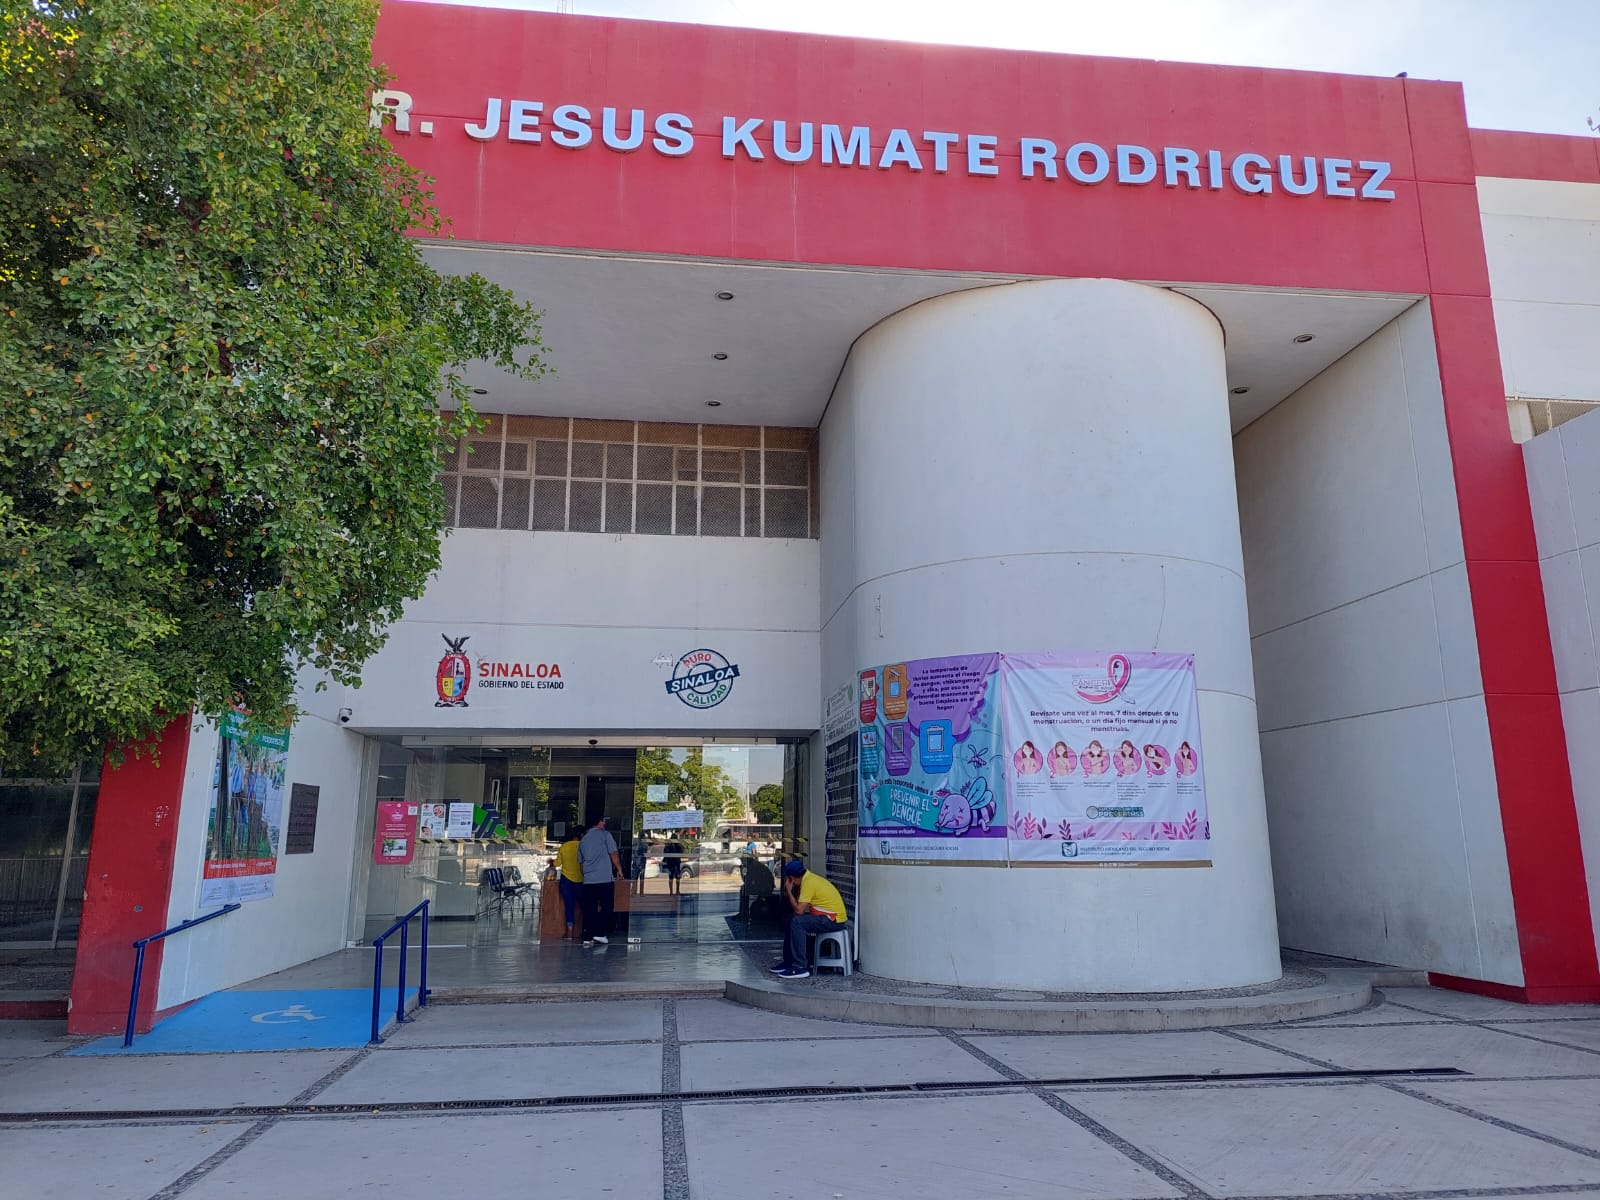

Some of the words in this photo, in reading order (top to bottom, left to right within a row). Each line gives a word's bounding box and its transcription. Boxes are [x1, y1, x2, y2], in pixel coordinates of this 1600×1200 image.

[464, 97, 695, 158] JESUS
[722, 116, 999, 178] KUMATE
[1020, 137, 1396, 201] RODRIGUEZ
[479, 662, 562, 678] SINALOA
[670, 667, 735, 693] SINALOA
[478, 680, 519, 689] GOBIERNO
[521, 681, 535, 689] DEL
[537, 681, 564, 690] ESTADO
[686, 684, 728, 705] CALIDAD
[1115, 718, 1126, 726] fijo
[890, 788, 921, 808] PREVENIR
[922, 798, 929, 811] EL
[891, 802, 922, 826] DENGUE
